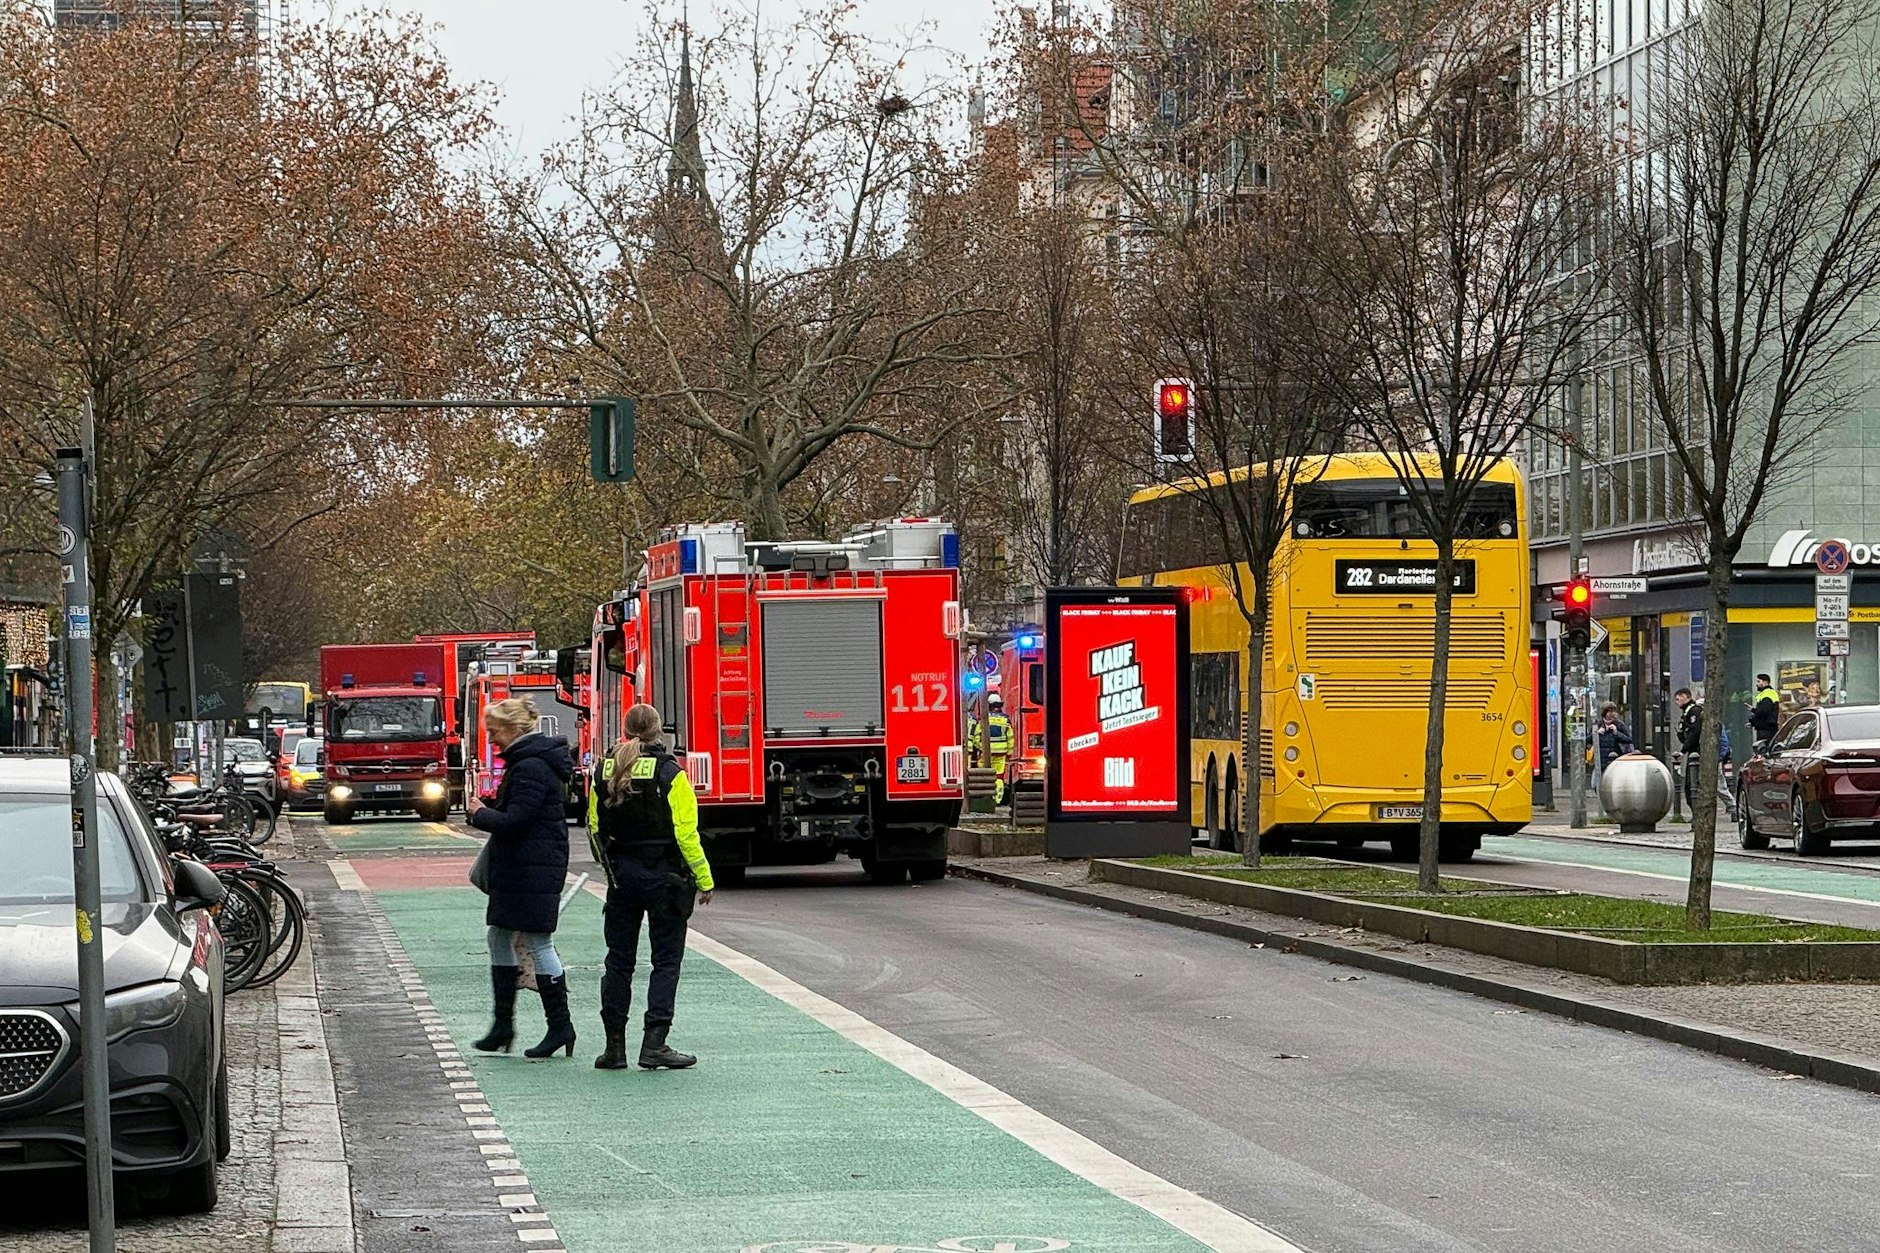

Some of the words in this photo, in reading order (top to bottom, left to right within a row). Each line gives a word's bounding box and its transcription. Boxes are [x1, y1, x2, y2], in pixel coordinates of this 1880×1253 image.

[1347, 568, 1373, 586] 282
[1379, 573, 1461, 586] Dardanelleg
[1593, 580, 1641, 590] Ahornstraße
[1092, 643, 1133, 675] KAUF
[911, 673, 947, 682] NOTRUF
[1103, 665, 1139, 695] KEIN
[891, 684, 948, 712] 112
[1100, 687, 1143, 719] KACK
[1481, 713, 1503, 722] 3654
[1070, 736, 1097, 749] checken
[605, 760, 655, 778] PZEI
[908, 759, 915, 768] B
[901, 769, 925, 778] 2881
[1387, 809, 1393, 817] B
[1406, 809, 1424, 817] 365
